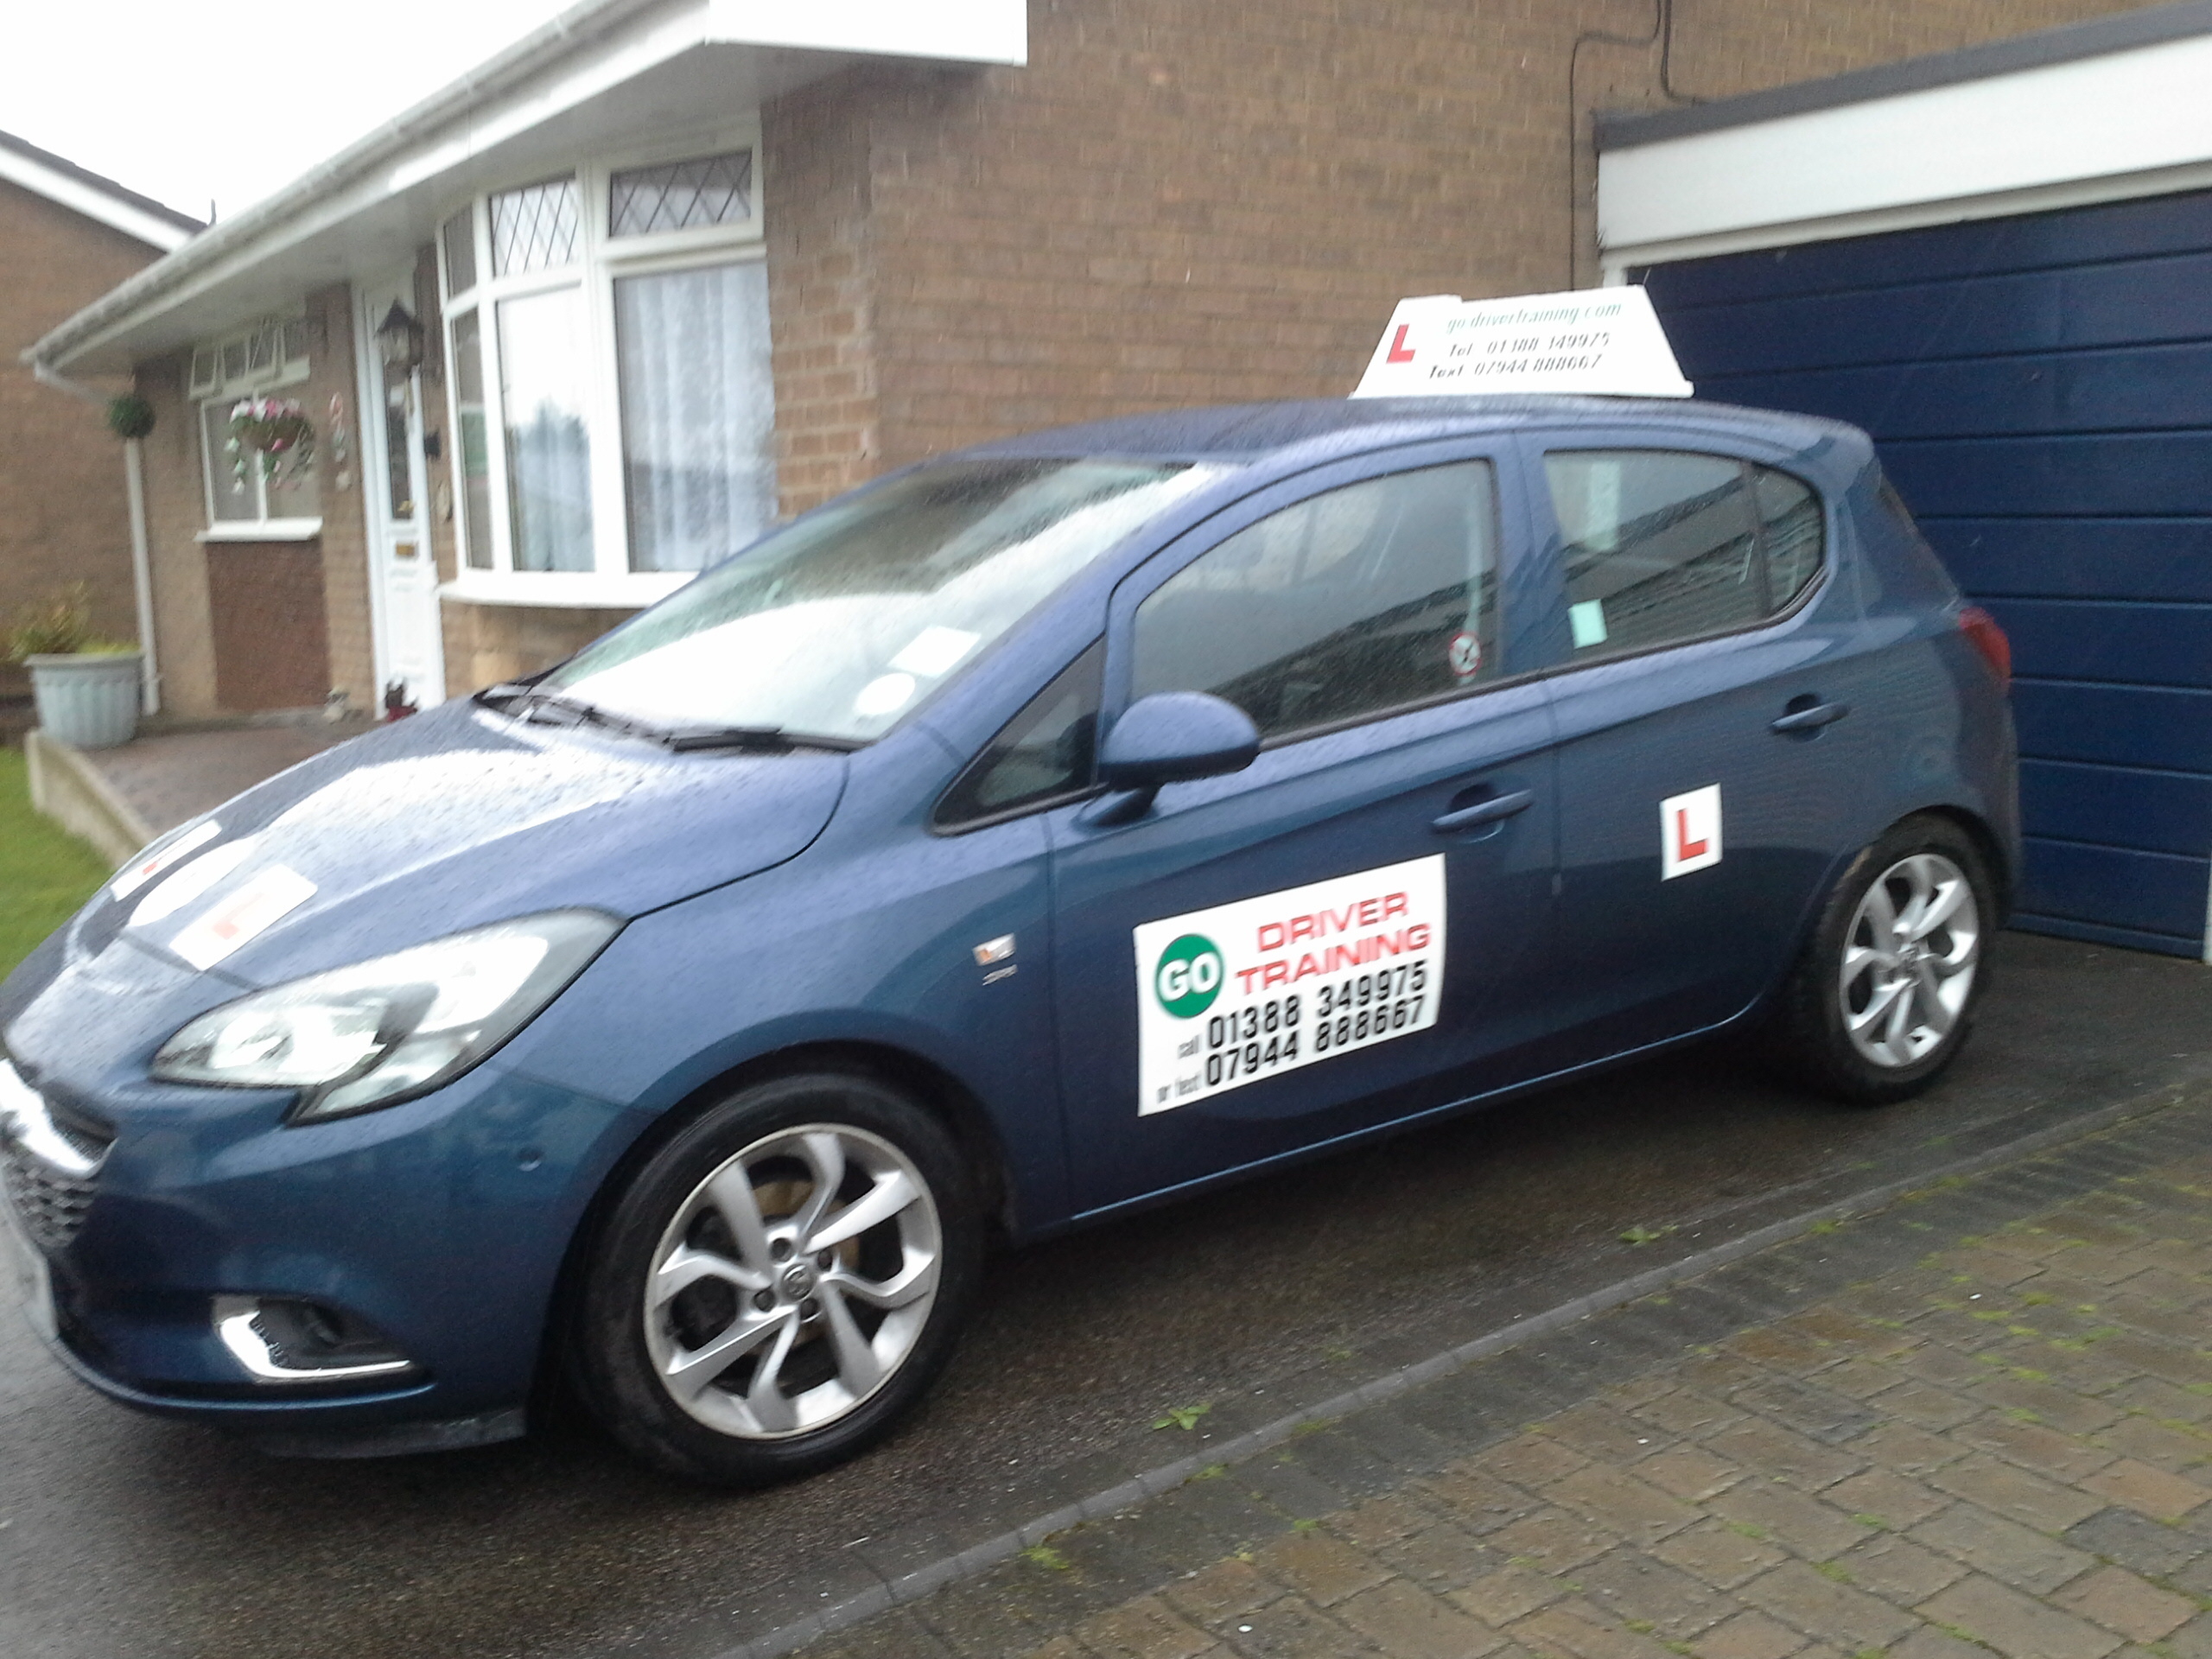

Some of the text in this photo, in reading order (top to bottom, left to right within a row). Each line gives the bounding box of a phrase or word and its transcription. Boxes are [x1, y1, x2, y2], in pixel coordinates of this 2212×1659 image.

[1386, 324, 1416, 364] L
[1474, 358, 1529, 376] 07944
[1676, 808, 1709, 862] L
[1256, 891, 1409, 953] DRIVER
[1158, 950, 1222, 1002] GO
[1235, 922, 1432, 996] TRAINING
[1209, 994, 1302, 1050] 01388
[1316, 959, 1428, 1019] 349975
[1205, 1029, 1300, 1087] 07944
[1313, 995, 1426, 1053] 888667
